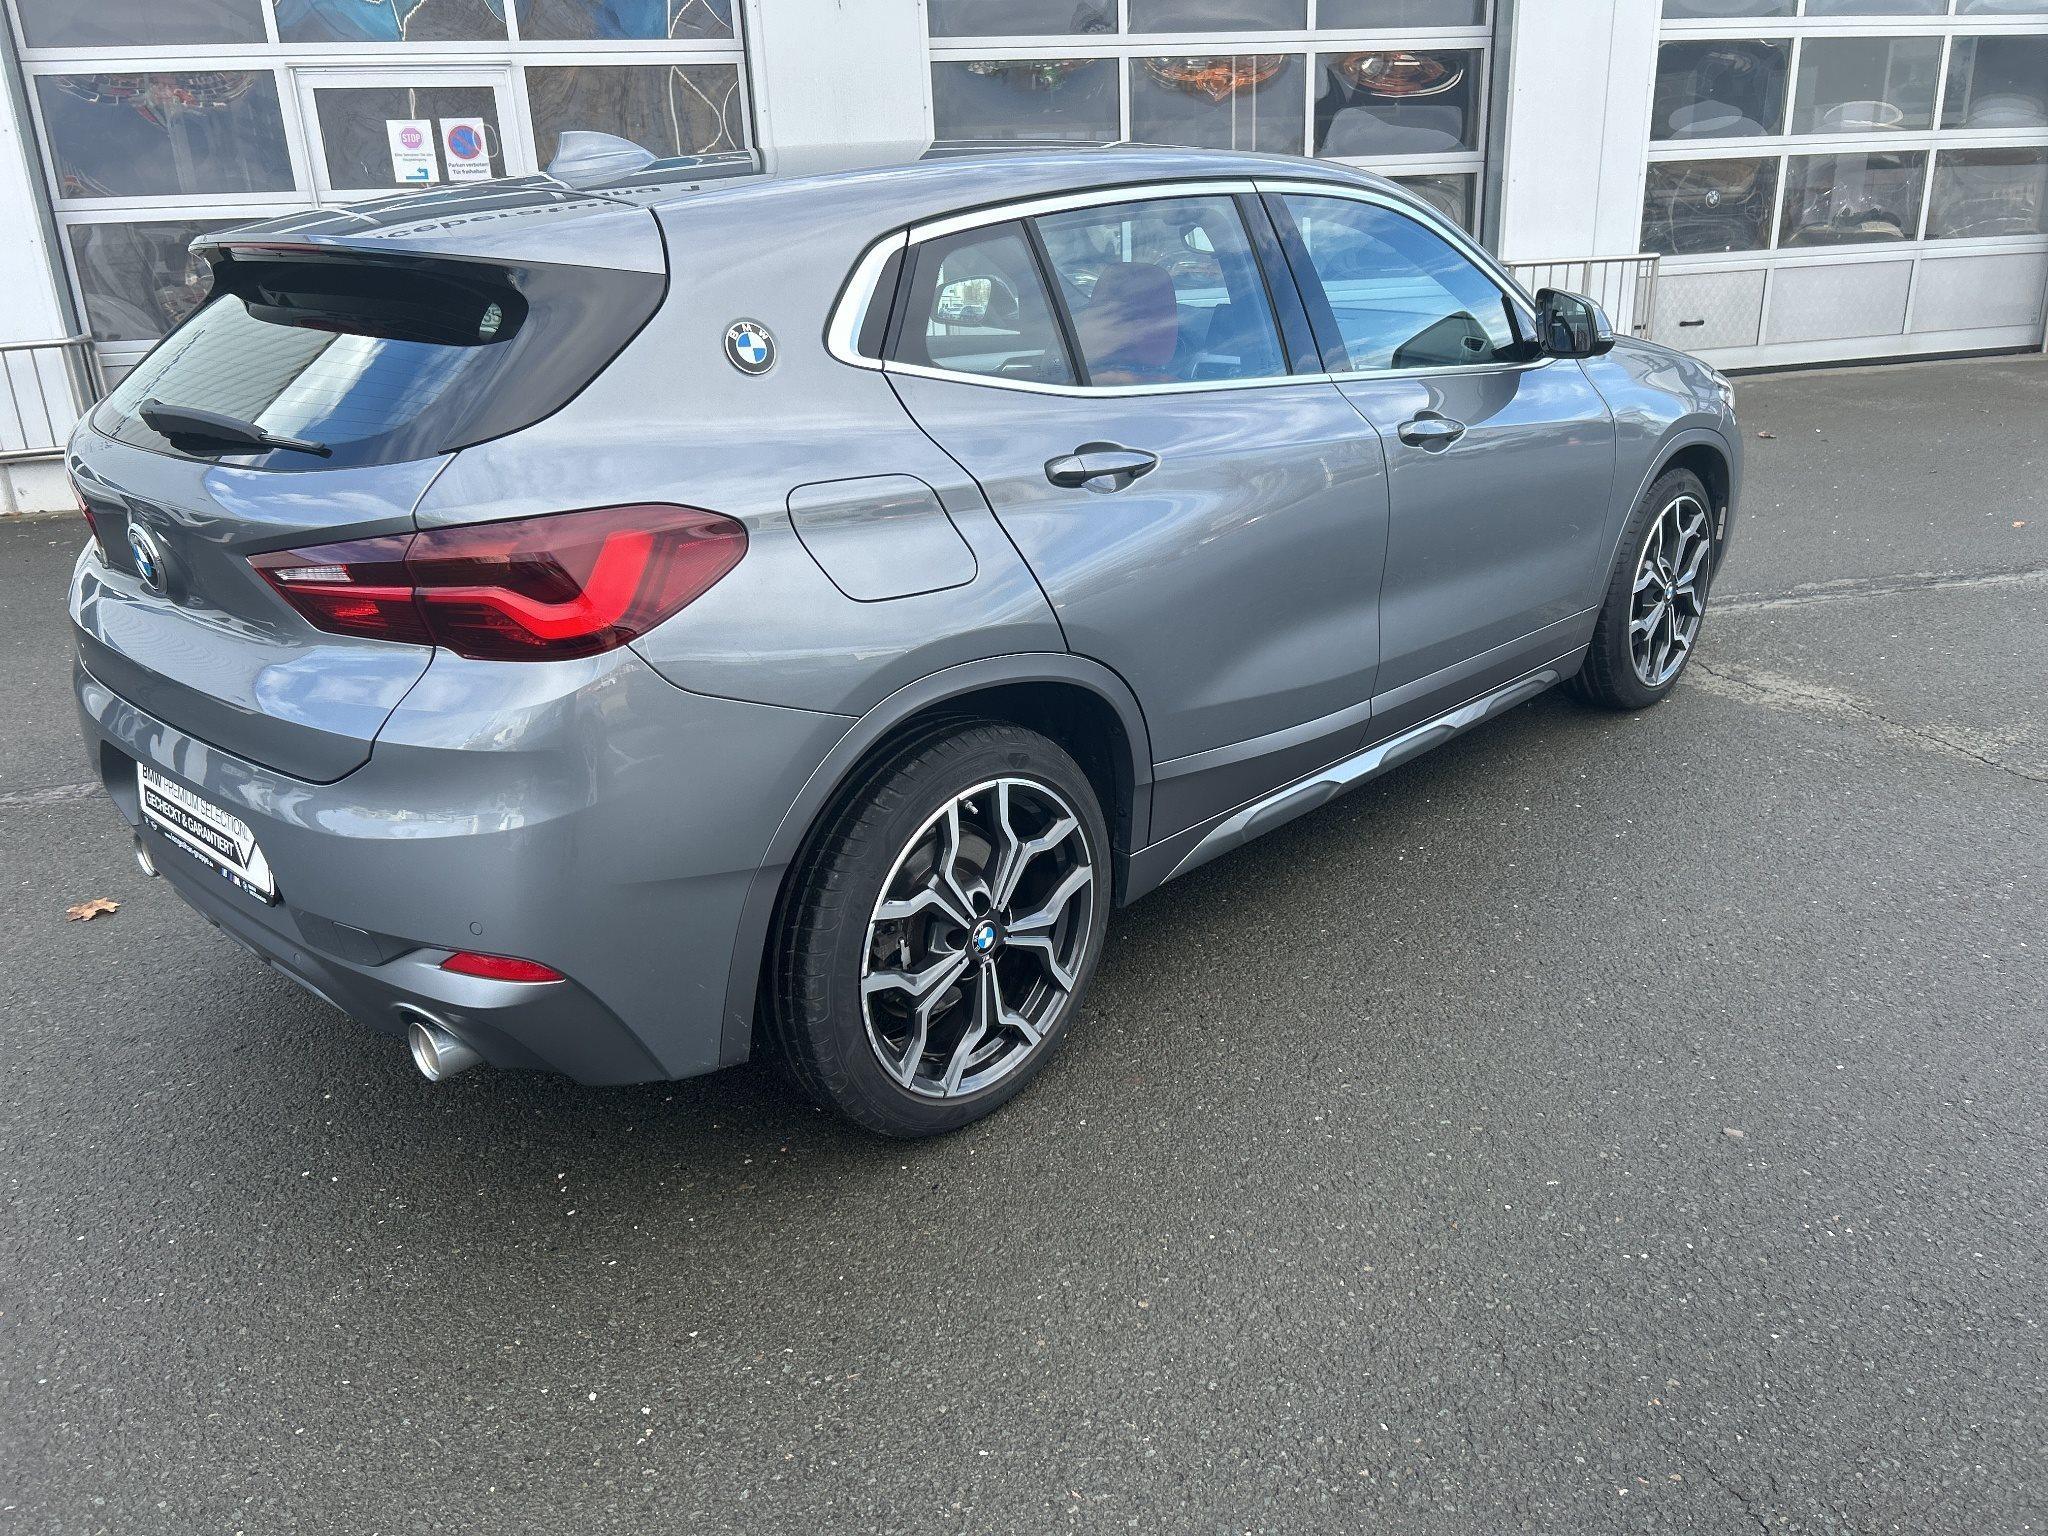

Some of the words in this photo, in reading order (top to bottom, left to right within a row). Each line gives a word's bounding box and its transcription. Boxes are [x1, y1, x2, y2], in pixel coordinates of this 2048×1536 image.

[402, 133, 421, 143] STOP
[728, 323, 769, 340] BMW
[143, 765, 161, 788] BMW
[163, 776, 199, 811] PREMIUM
[146, 790, 182, 824] GECHECKT
[181, 817, 188, 829] &
[188, 819, 235, 857] GARANTIERT
